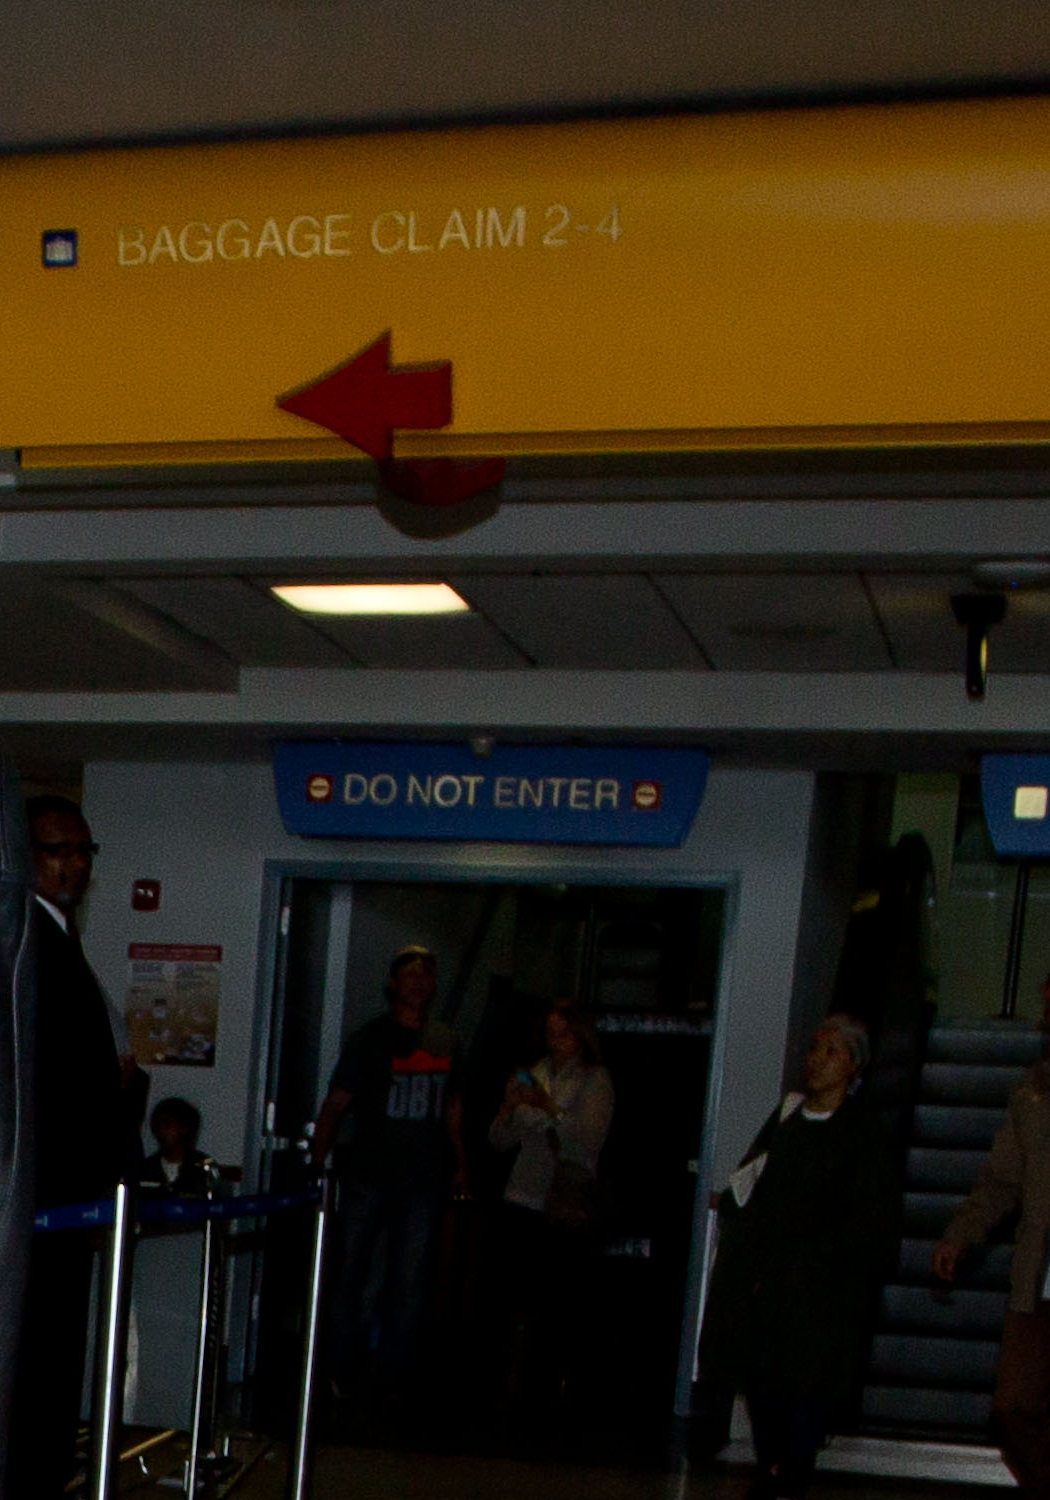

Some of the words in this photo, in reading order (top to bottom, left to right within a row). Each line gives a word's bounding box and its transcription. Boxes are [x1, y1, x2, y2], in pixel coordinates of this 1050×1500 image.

[118, 214, 351, 266] BAGGAGE
[370, 205, 527, 255] CLAIM
[542, 202, 623, 247] 2-4
[342, 773, 398, 807] DO
[406, 773, 485, 808] NOT
[493, 777, 620, 811] ENTER
